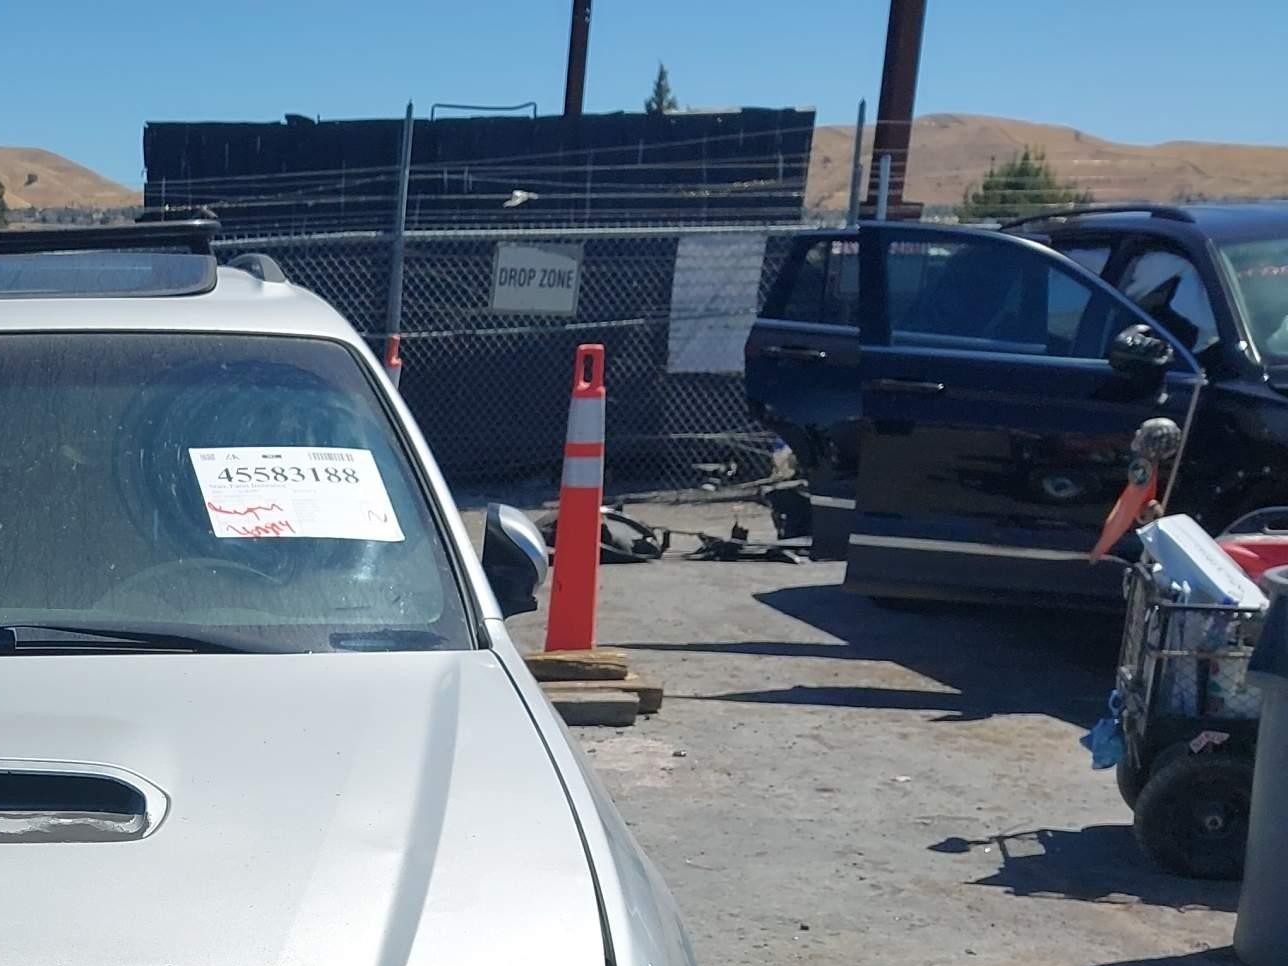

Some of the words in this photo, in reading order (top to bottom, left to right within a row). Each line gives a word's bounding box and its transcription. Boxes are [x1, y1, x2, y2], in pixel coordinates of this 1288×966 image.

[499, 267, 536, 287] DROP
[539, 268, 573, 289] ZONE
[218, 466, 359, 484] 45583188
